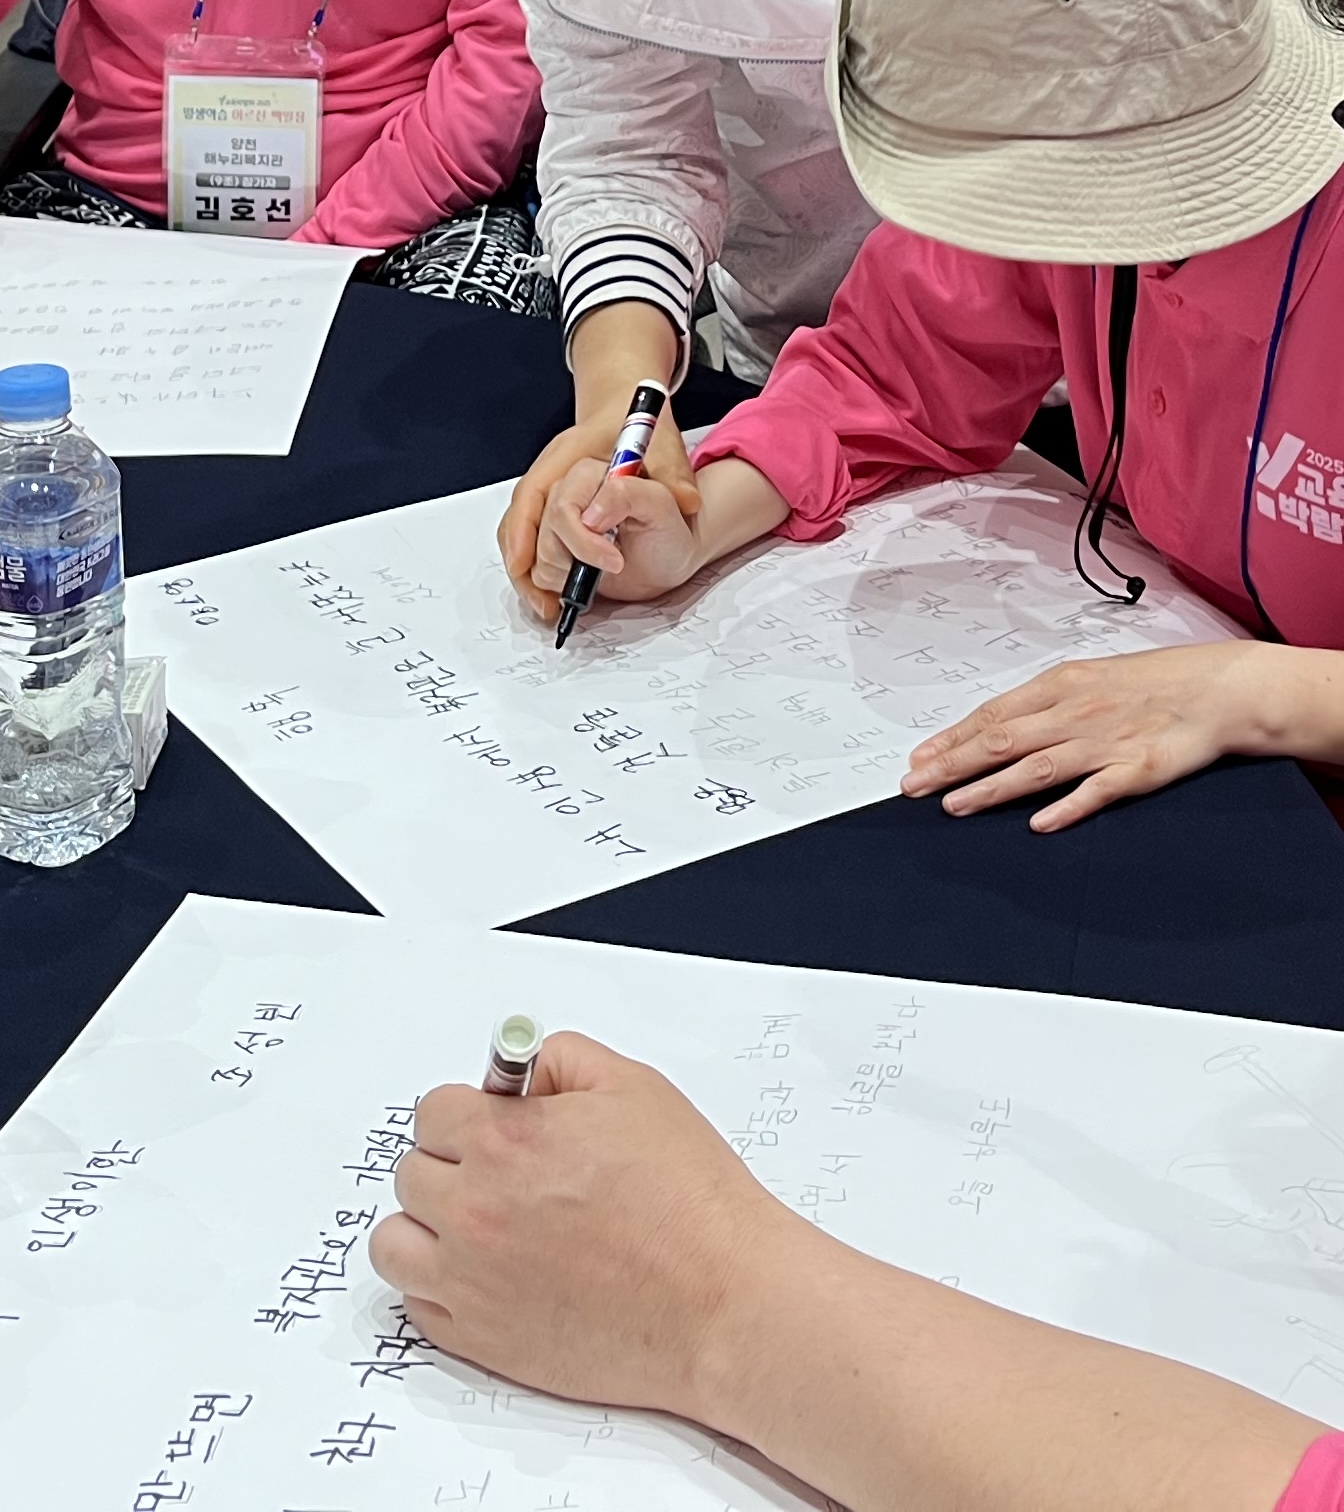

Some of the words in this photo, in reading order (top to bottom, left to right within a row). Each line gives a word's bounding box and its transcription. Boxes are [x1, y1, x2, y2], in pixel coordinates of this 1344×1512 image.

[195, 196, 292, 223] 김호선
[1306, 449, 1344, 474] 2025
[240, 685, 314, 743] 행복
[582, 822, 648, 858] 내
[211, 1000, 304, 1087] 조성빈
